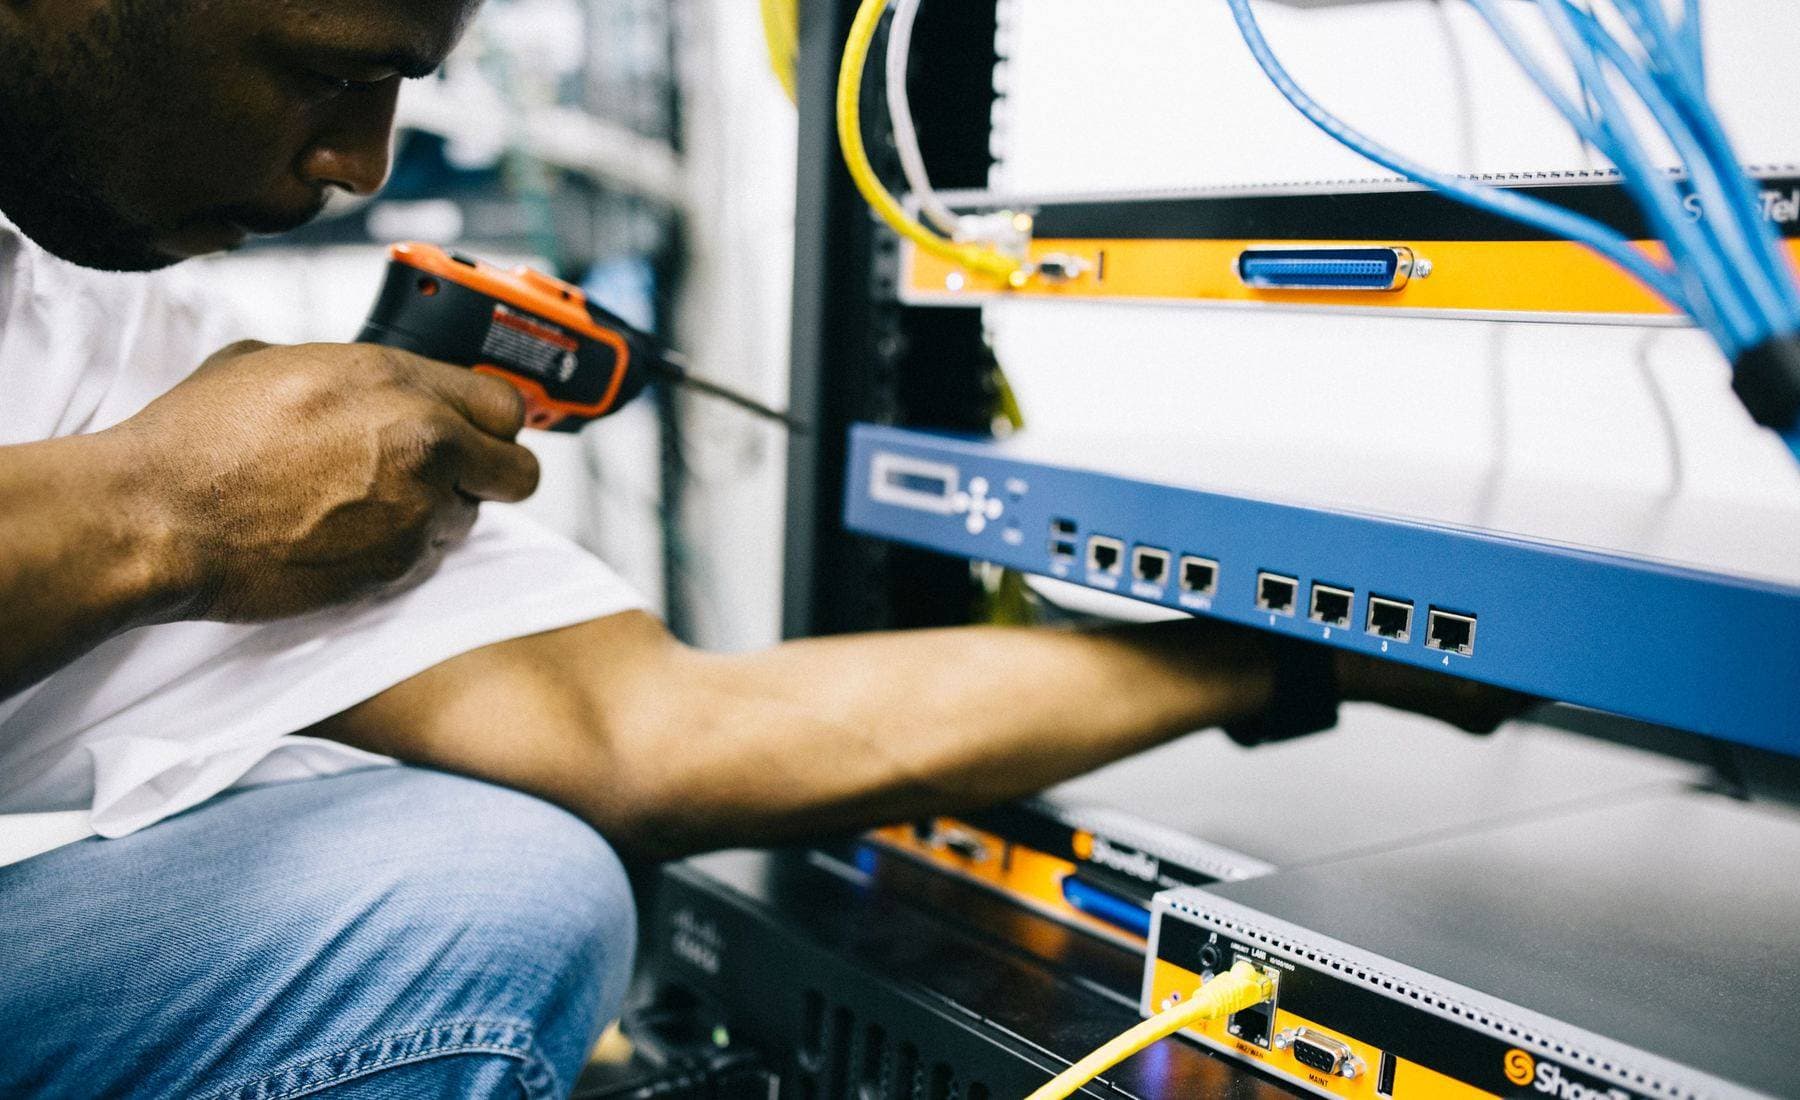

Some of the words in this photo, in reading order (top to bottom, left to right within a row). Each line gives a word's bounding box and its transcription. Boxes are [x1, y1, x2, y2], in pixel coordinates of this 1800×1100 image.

[1323, 627, 1331, 639] 2
[1381, 640, 1388, 652] 3
[1441, 655, 1449, 667] 4
[1309, 1073, 1328, 1087] MAINT
